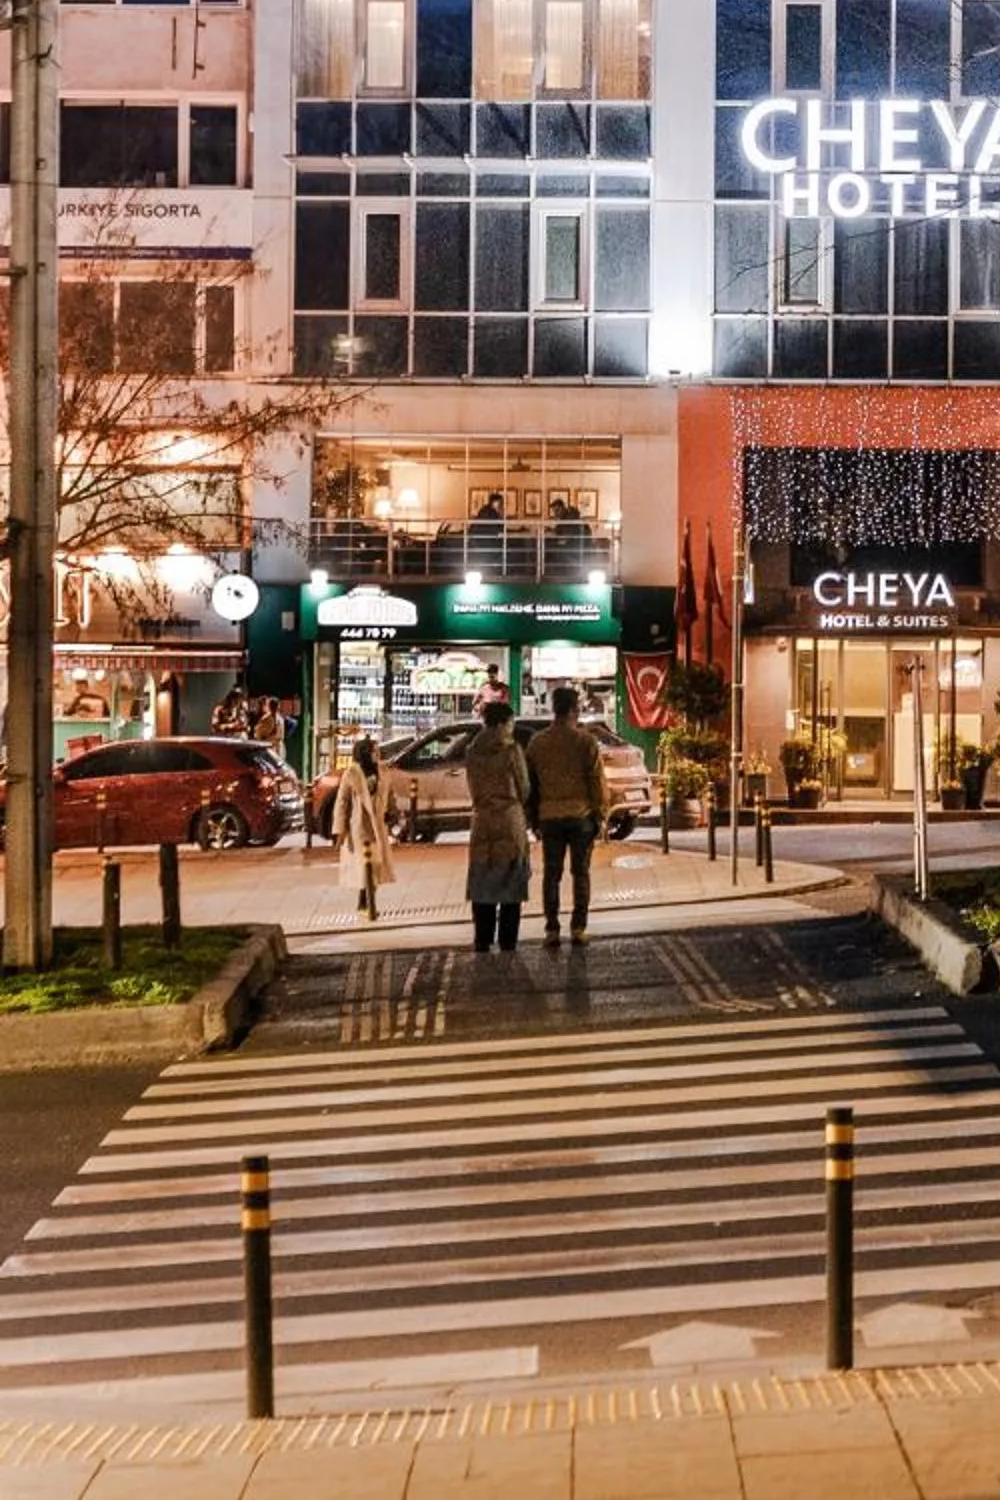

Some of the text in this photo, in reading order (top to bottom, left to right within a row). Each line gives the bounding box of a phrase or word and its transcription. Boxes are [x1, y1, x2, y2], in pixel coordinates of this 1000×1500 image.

[782, 172, 1000, 218] HOTEL
[813, 571, 955, 607] CHEYA
[820, 613, 949, 628] HOTEL & SUITES
